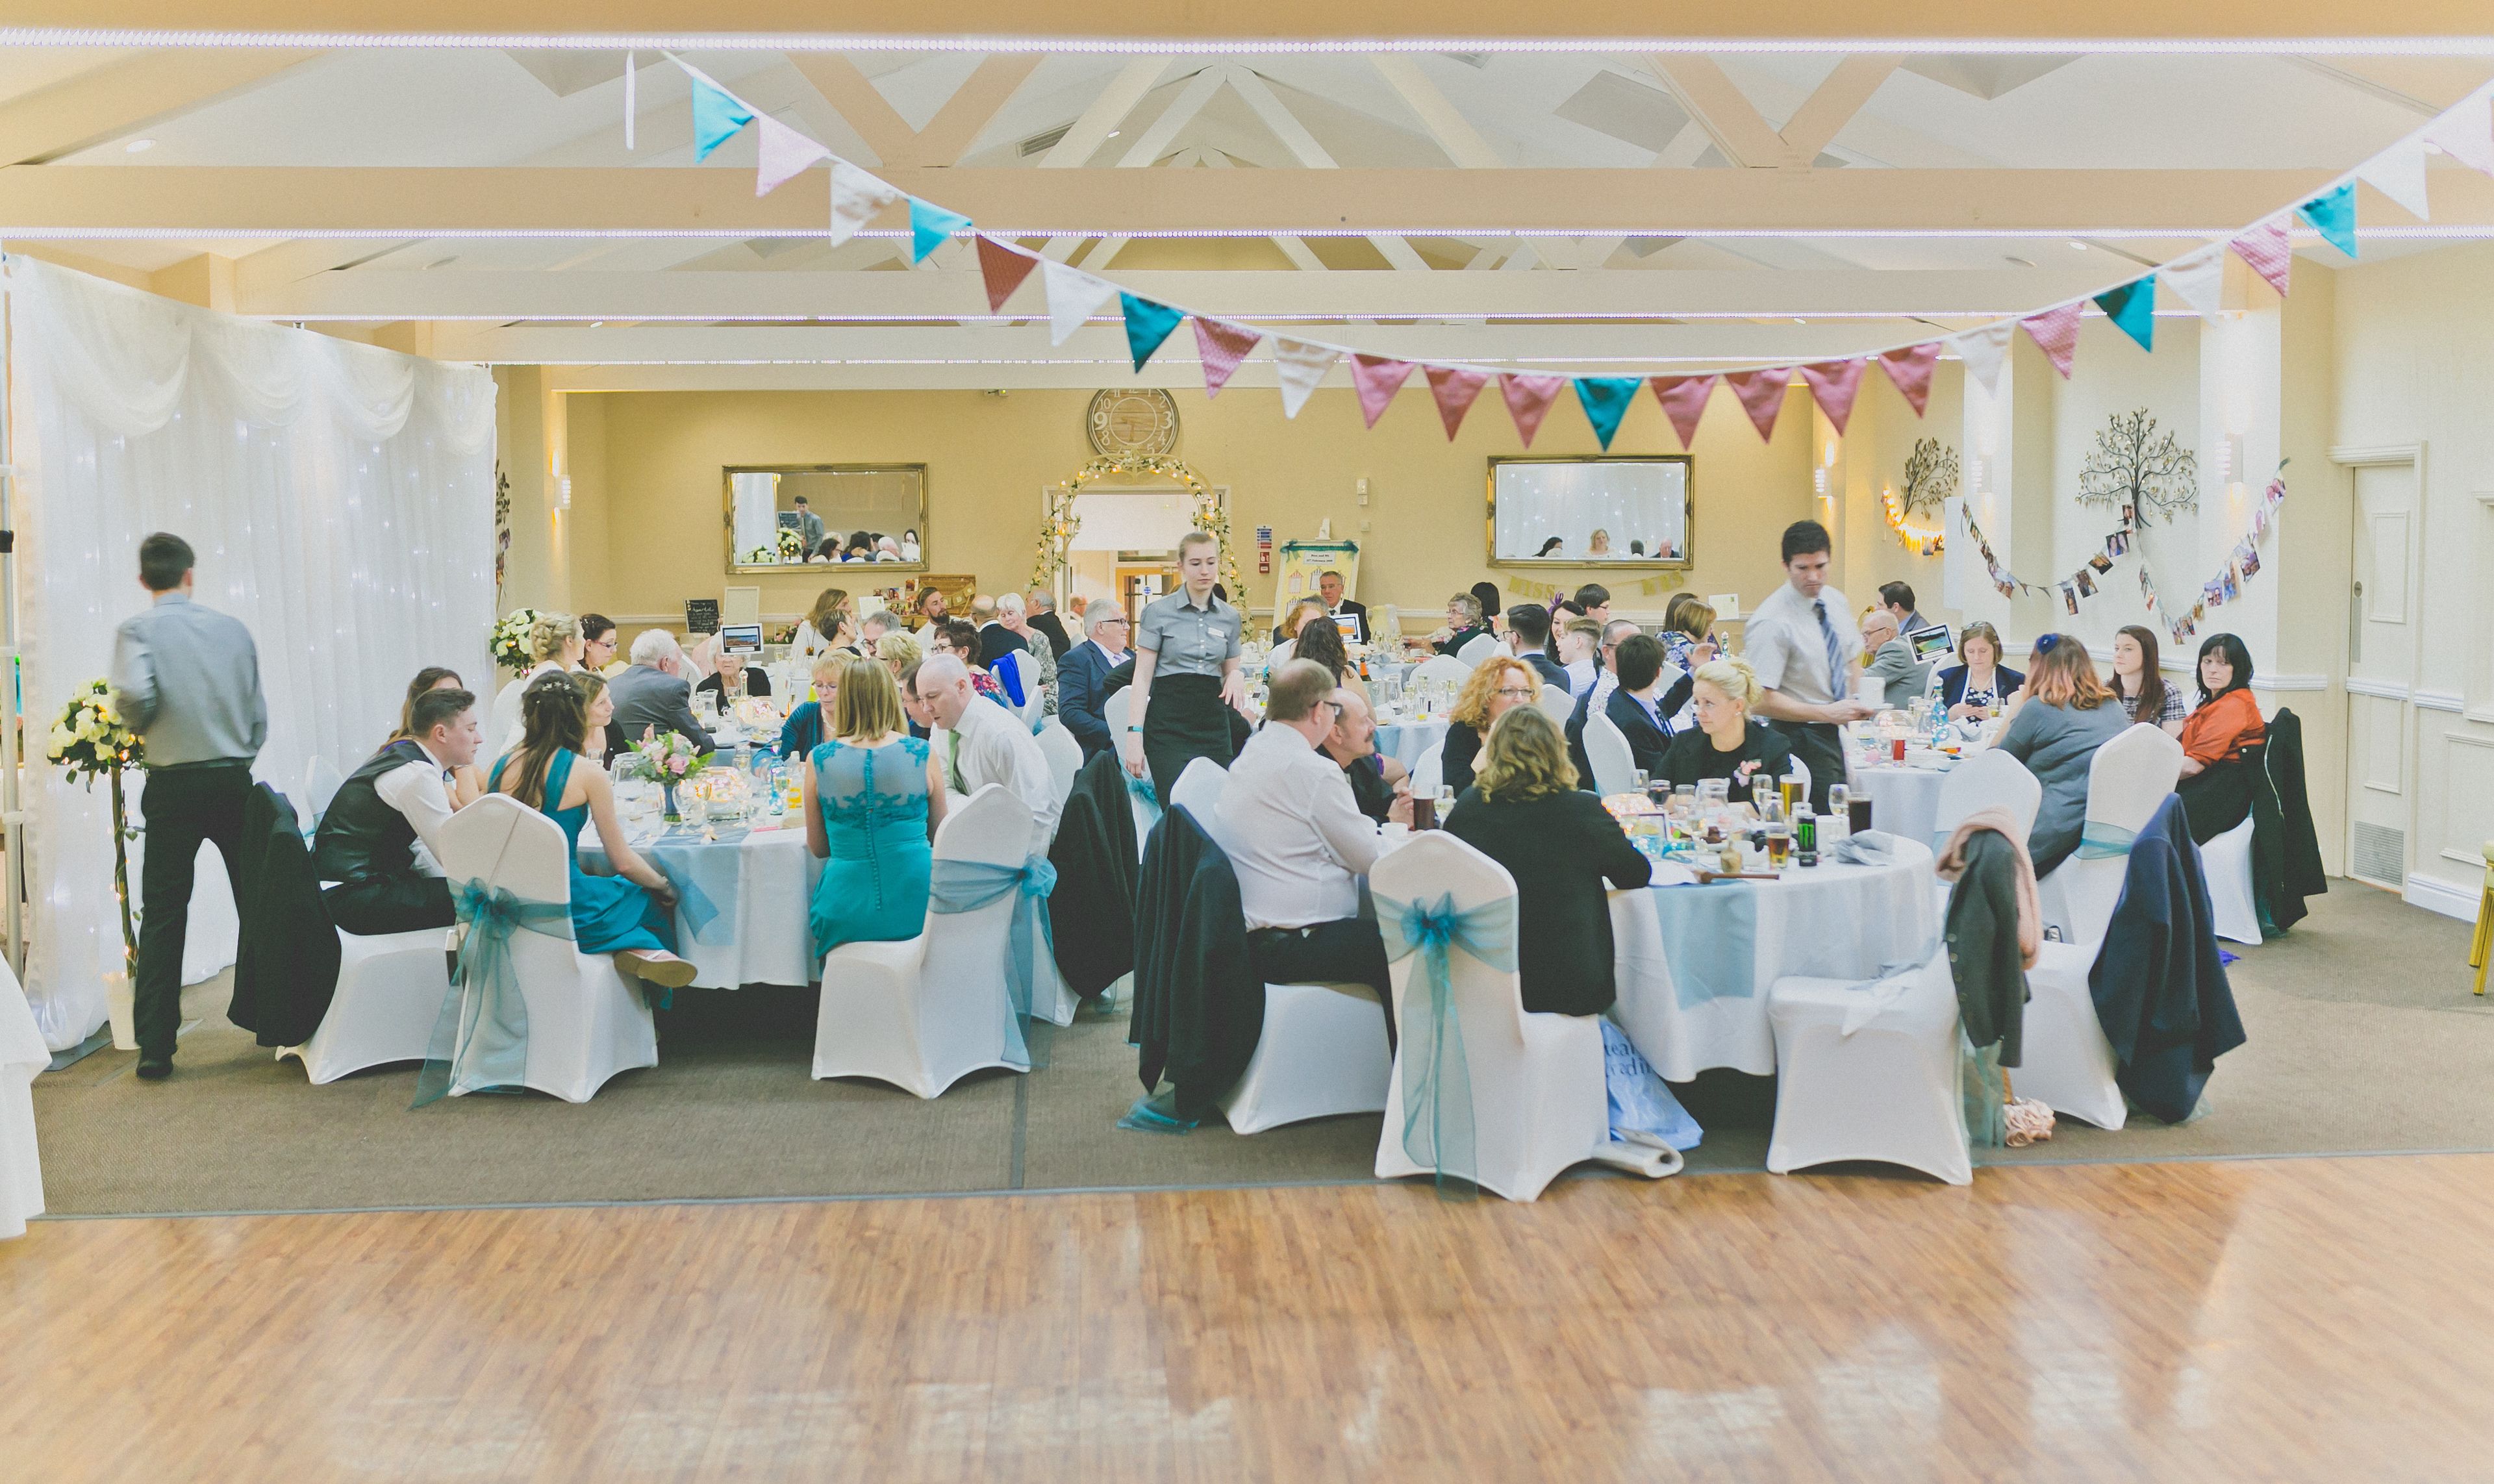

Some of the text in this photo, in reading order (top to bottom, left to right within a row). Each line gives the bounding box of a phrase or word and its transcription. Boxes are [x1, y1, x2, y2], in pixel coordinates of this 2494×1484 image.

[1100, 397, 1111, 410] 10
[1159, 396, 1166, 409] 2
[1094, 412, 1108, 431] 9
[1160, 411, 1172, 429] 3
[1102, 429, 1110, 446] 8
[1158, 429, 1166, 446] 4
[1147, 442, 1155, 454] 5
[1507, 575, 1555, 600] MISS
